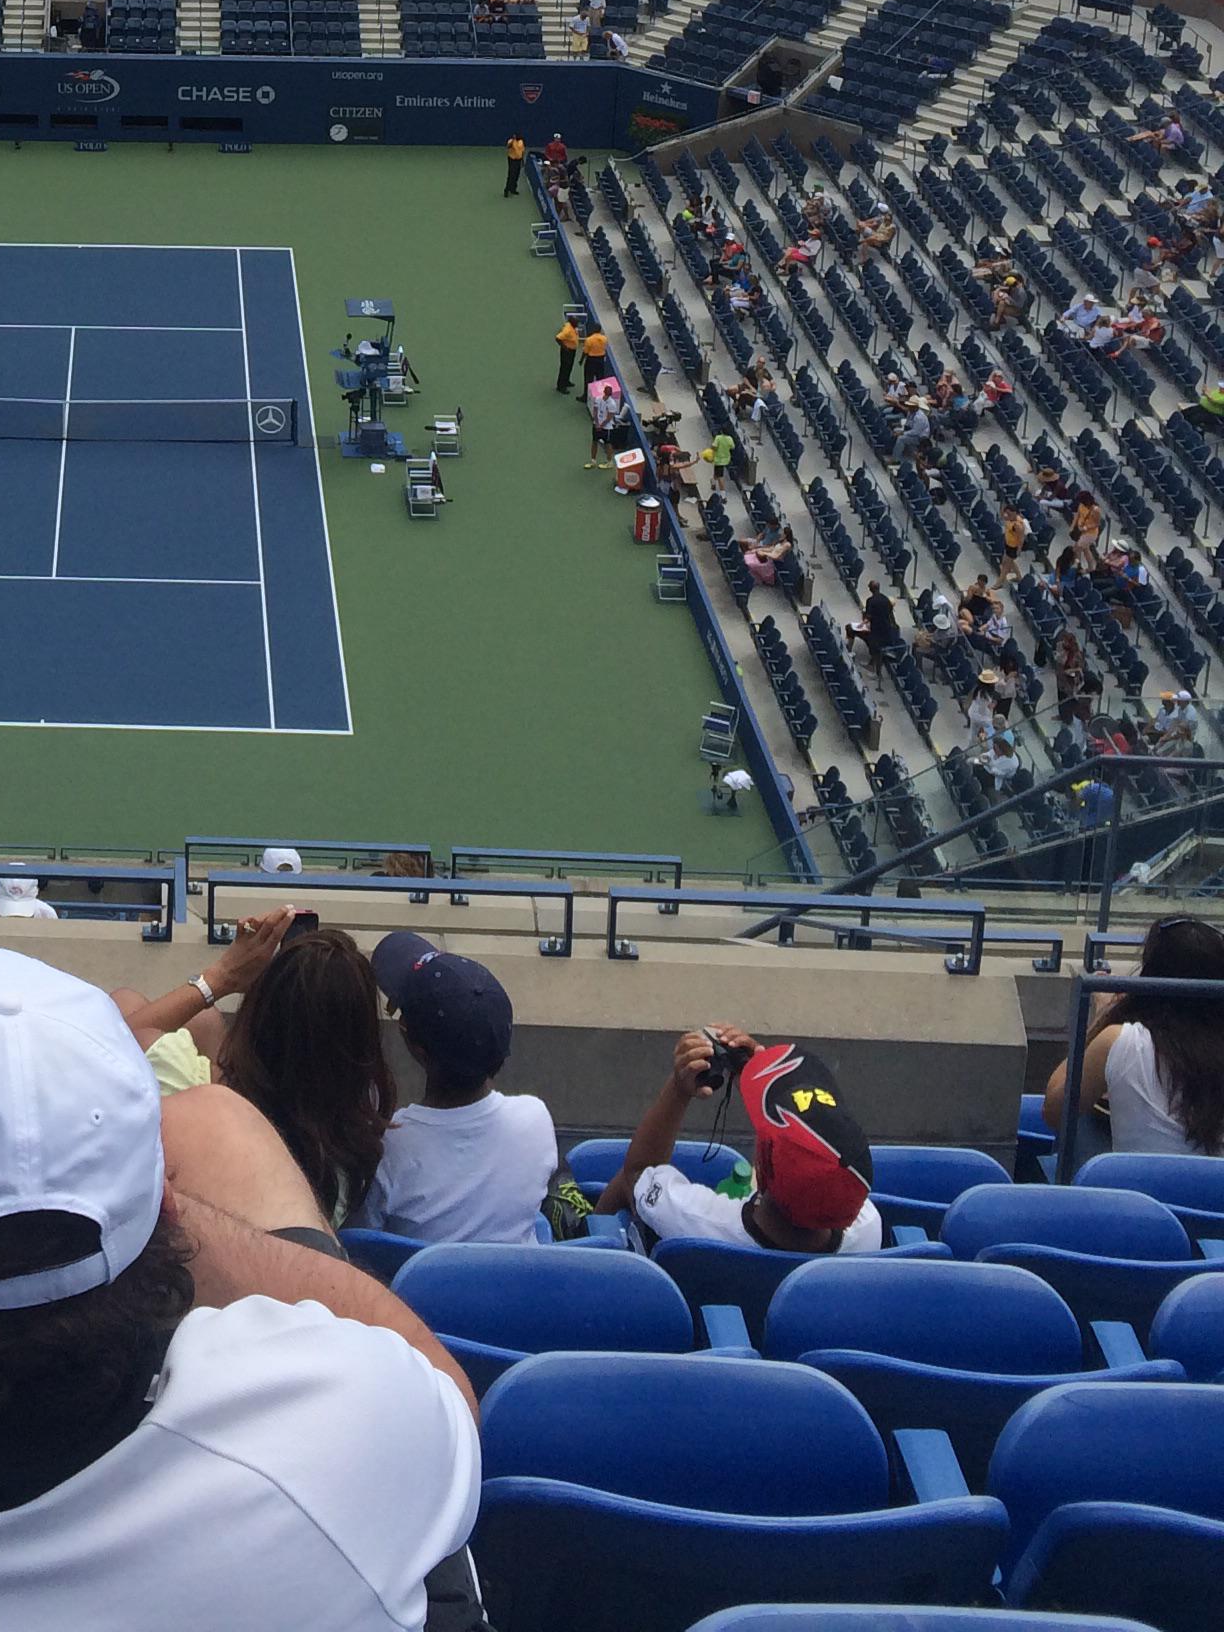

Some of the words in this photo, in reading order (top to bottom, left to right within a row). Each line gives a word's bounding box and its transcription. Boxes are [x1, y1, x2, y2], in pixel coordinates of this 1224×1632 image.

[331, 71, 384, 81] usopen.org
[57, 82, 73, 94] US
[75, 82, 112, 95] OPEN
[177, 86, 252, 102] CHASE
[395, 95, 450, 108] Emirates
[453, 95, 496, 108] Airline
[642, 90, 688, 111] Heineken
[329, 106, 383, 118] CITIZEN
